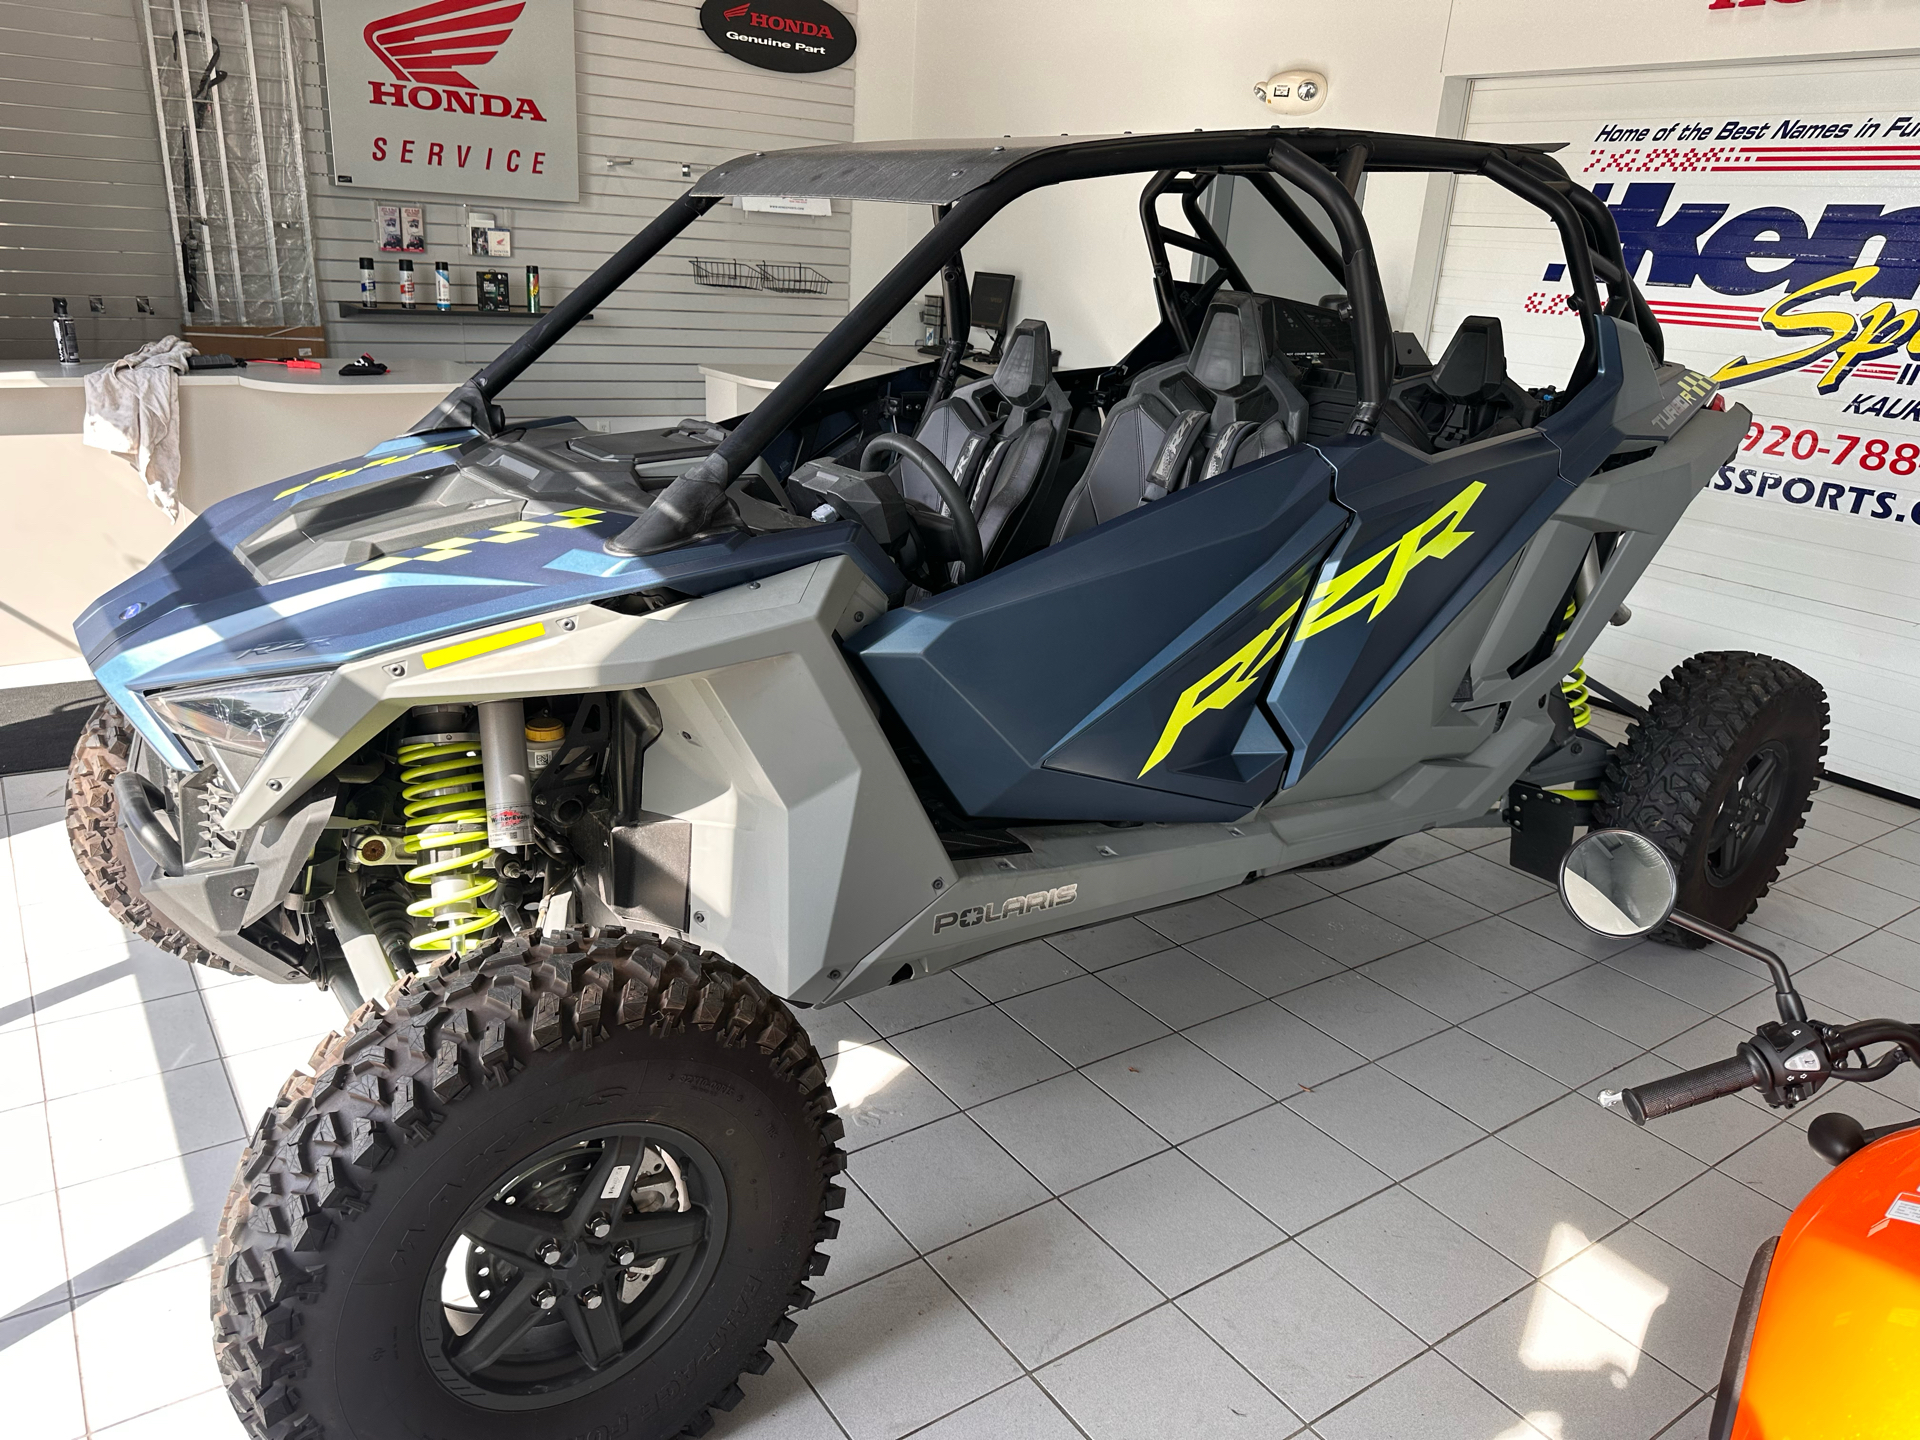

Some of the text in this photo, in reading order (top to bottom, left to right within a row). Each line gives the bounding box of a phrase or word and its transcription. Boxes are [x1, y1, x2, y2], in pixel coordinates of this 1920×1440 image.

[726, 31, 826, 54] Genuine Part
[750, 12, 834, 39] HONDA
[368, 81, 547, 122] HONDA
[1594, 116, 1920, 142] Home of the Best Names in Fu
[372, 137, 546, 174] SERVICE
[1651, 395, 1690, 430] TURBO
[1741, 421, 1920, 476] 920-788
[1705, 465, 1920, 525] SSPORTS.
[1137, 480, 1487, 780] RZR
[932, 883, 1078, 935] POLARIS
